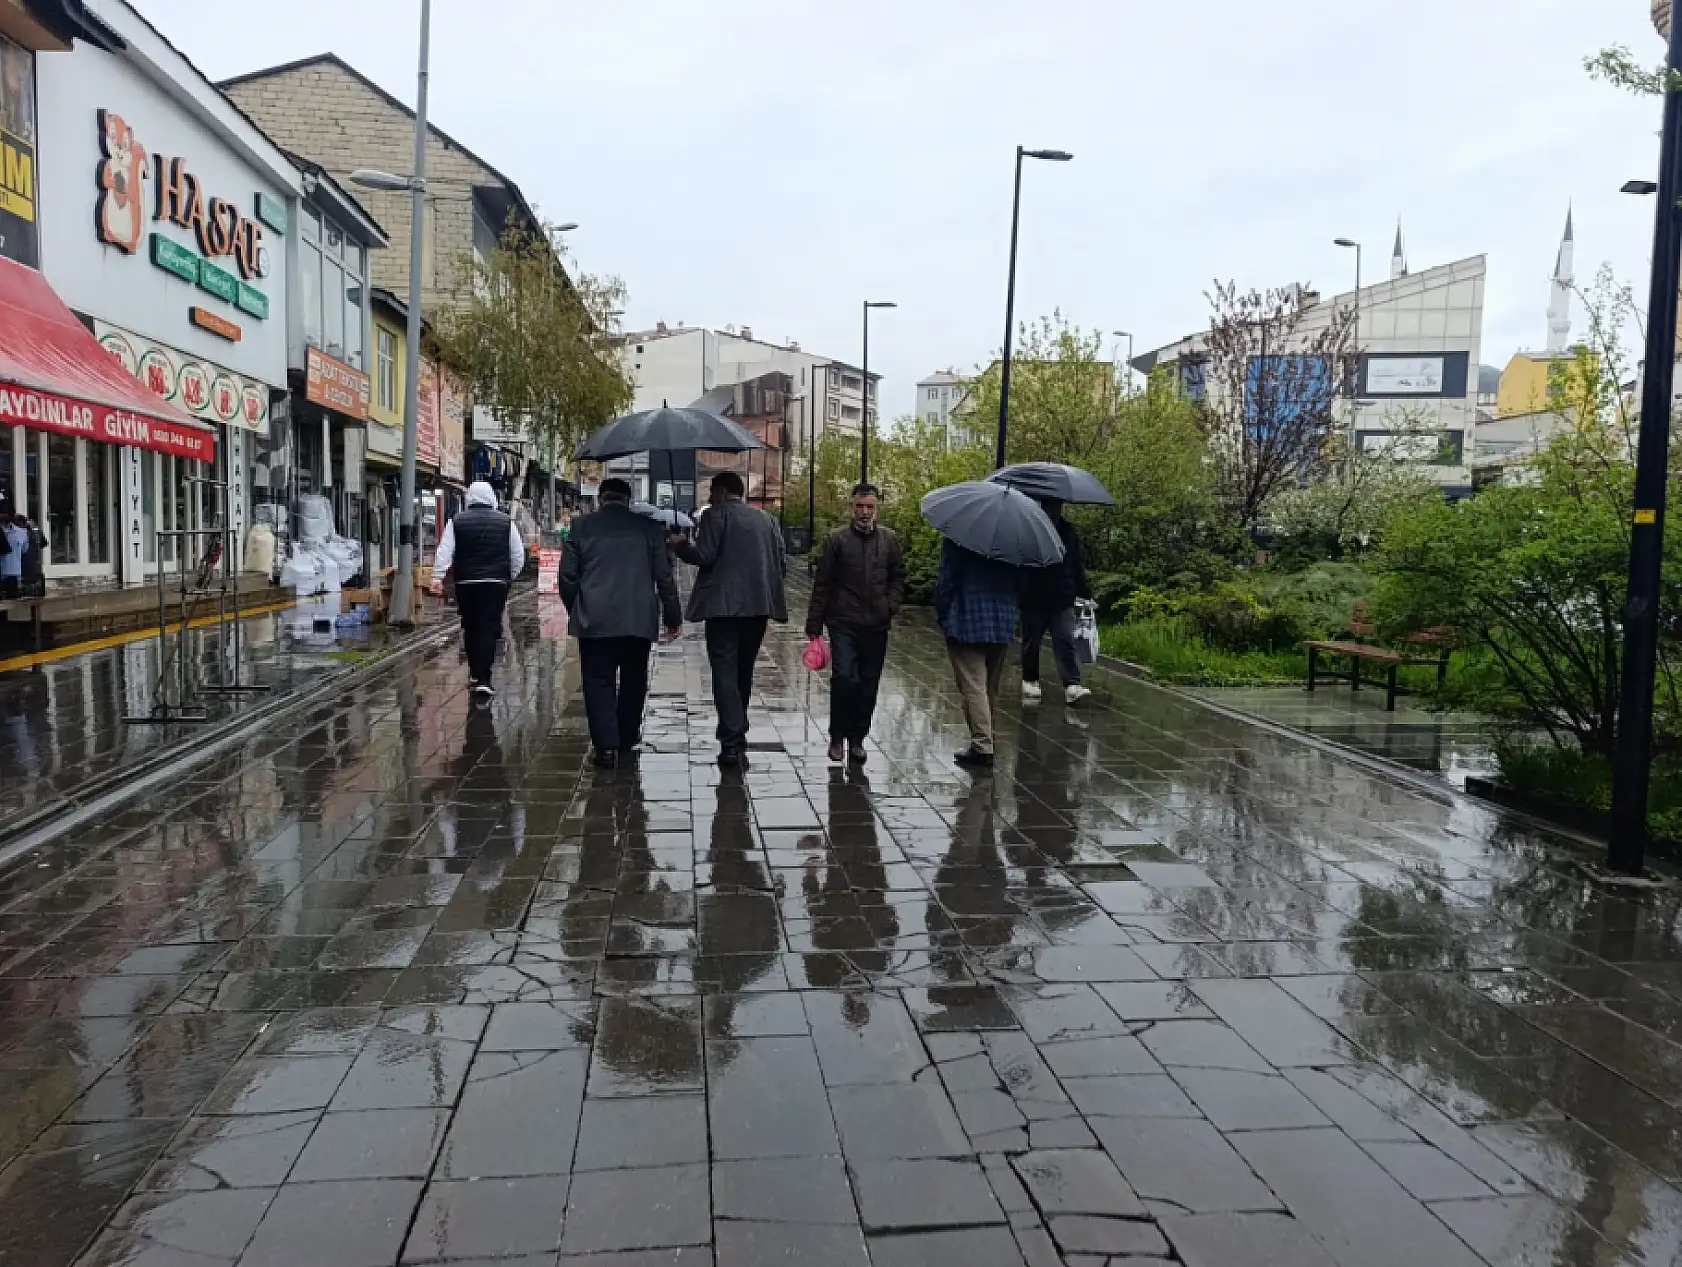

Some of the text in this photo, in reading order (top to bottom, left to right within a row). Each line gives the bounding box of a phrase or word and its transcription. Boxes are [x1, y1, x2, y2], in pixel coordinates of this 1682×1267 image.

[153, 153, 263, 279] HASAT
[0, 389, 94, 431] AYDINLAR
[104, 410, 150, 443] GİYİM
